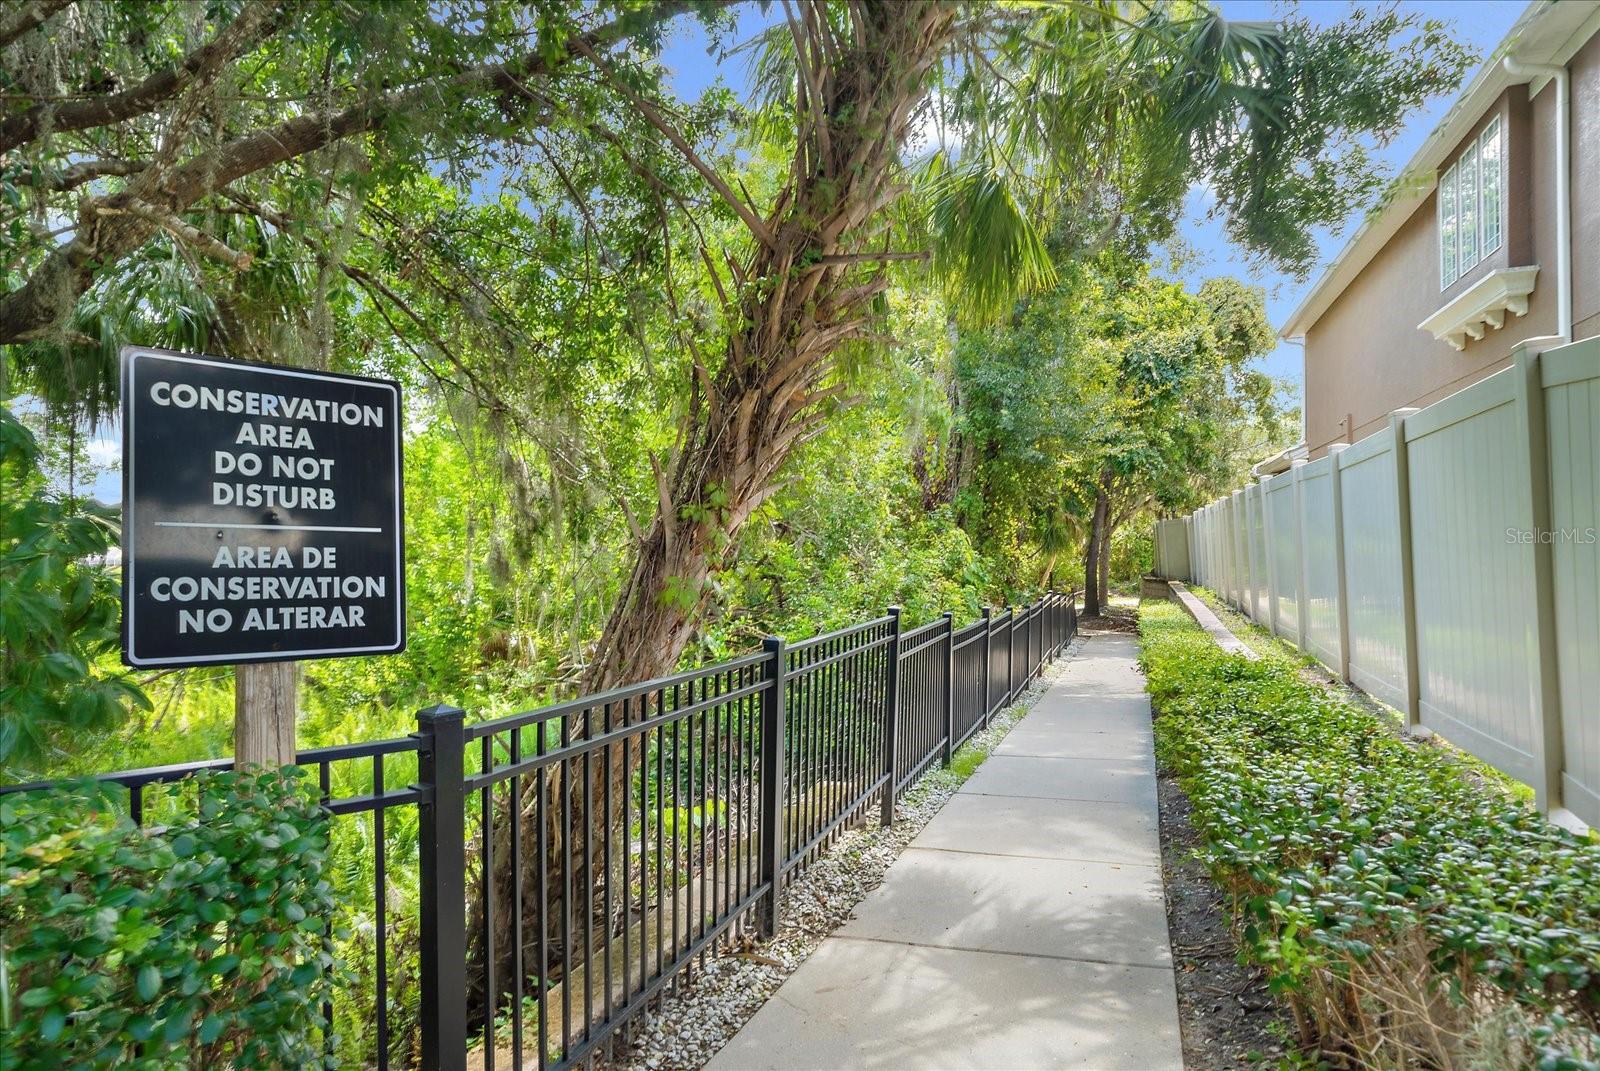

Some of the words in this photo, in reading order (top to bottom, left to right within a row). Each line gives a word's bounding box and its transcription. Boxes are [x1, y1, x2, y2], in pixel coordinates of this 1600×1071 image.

[150, 381, 384, 428] CONSERVATION
[235, 422, 315, 450] AREA
[215, 450, 262, 476] DO
[272, 455, 335, 481] NOT
[213, 482, 336, 510] DISTURB
[212, 545, 294, 569] AREA
[302, 546, 336, 569] DE
[150, 576, 385, 602] CONSERVATION
[179, 608, 233, 634] NO
[241, 605, 366, 631] ALTERAR
